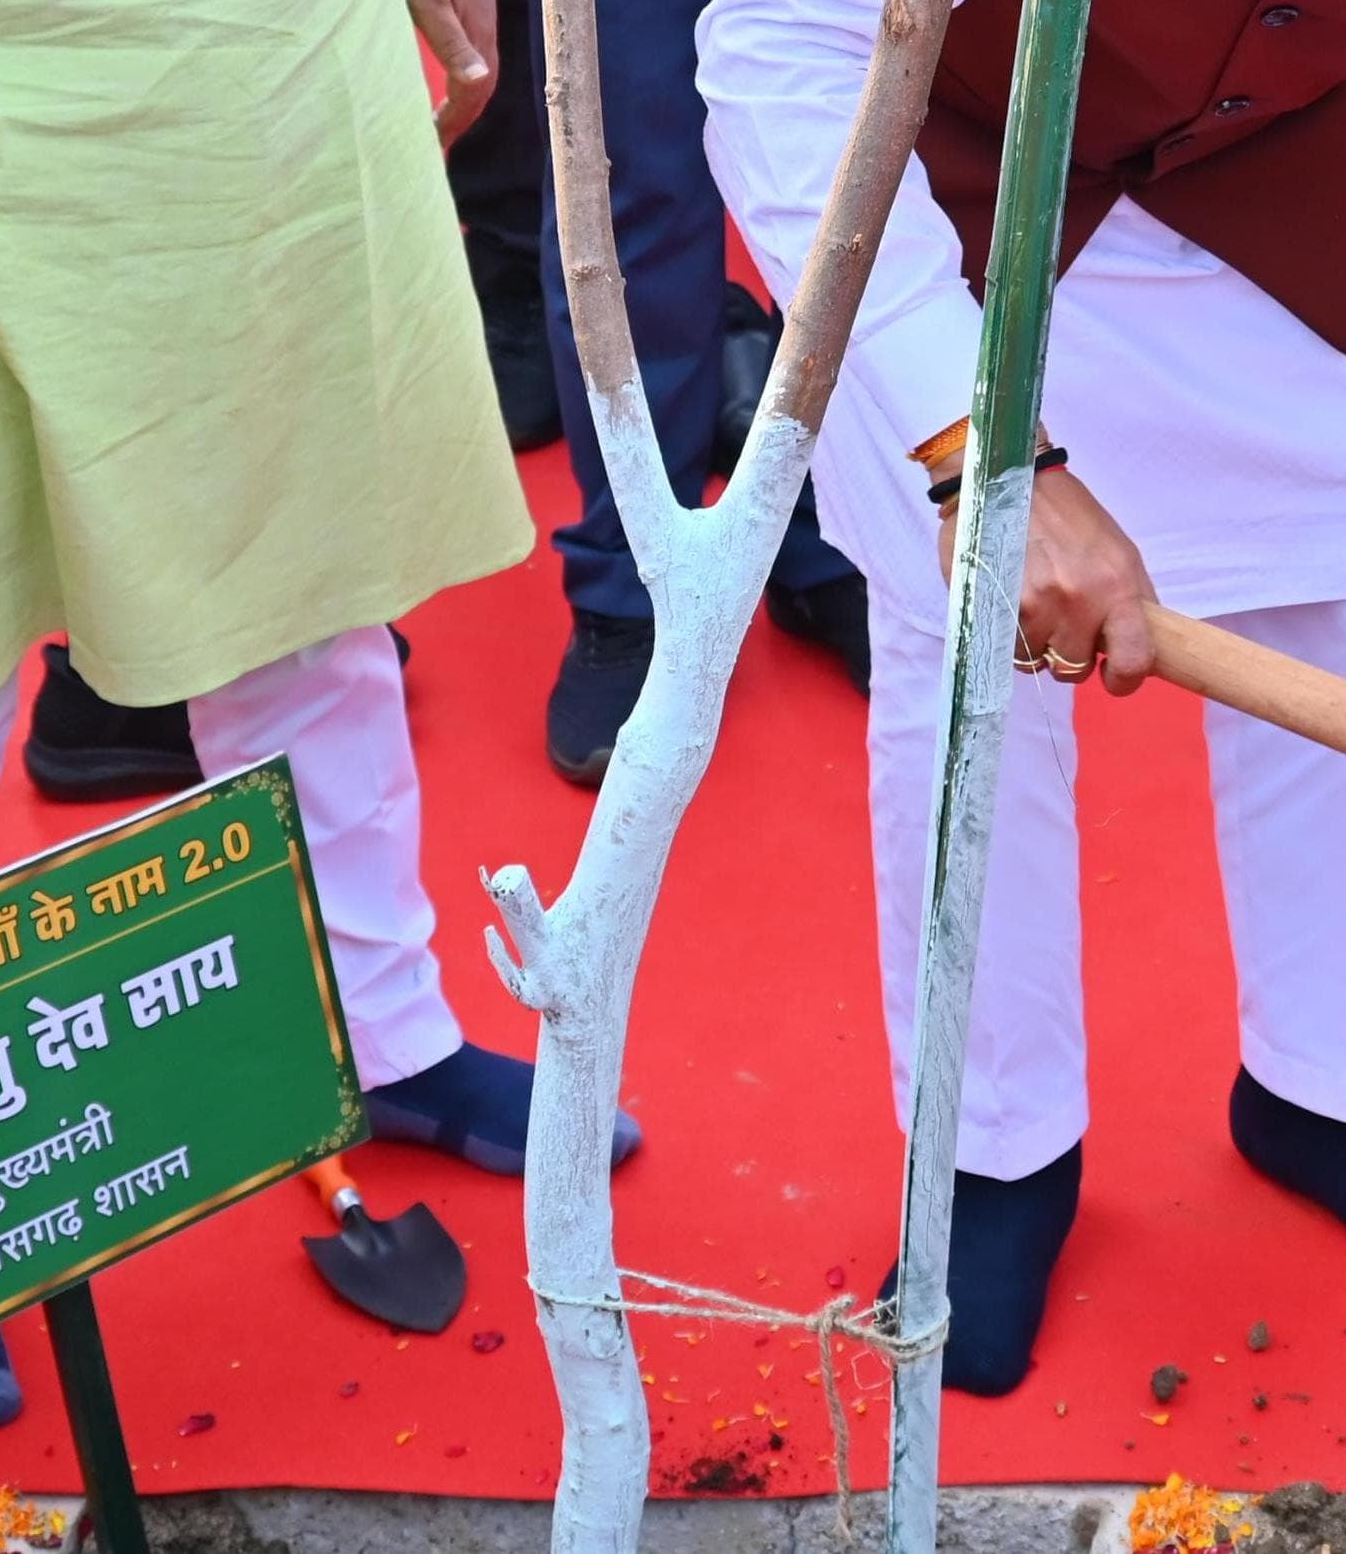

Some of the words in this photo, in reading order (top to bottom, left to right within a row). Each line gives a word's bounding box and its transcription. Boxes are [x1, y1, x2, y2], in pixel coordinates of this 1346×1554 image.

[29, 890, 77, 941] के
[85, 855, 167, 916] नाम
[178, 821, 253, 884] 2.0
[26, 996, 111, 1073] देव
[120, 933, 240, 1030] साय
[93, 1145, 192, 1218] शासन
